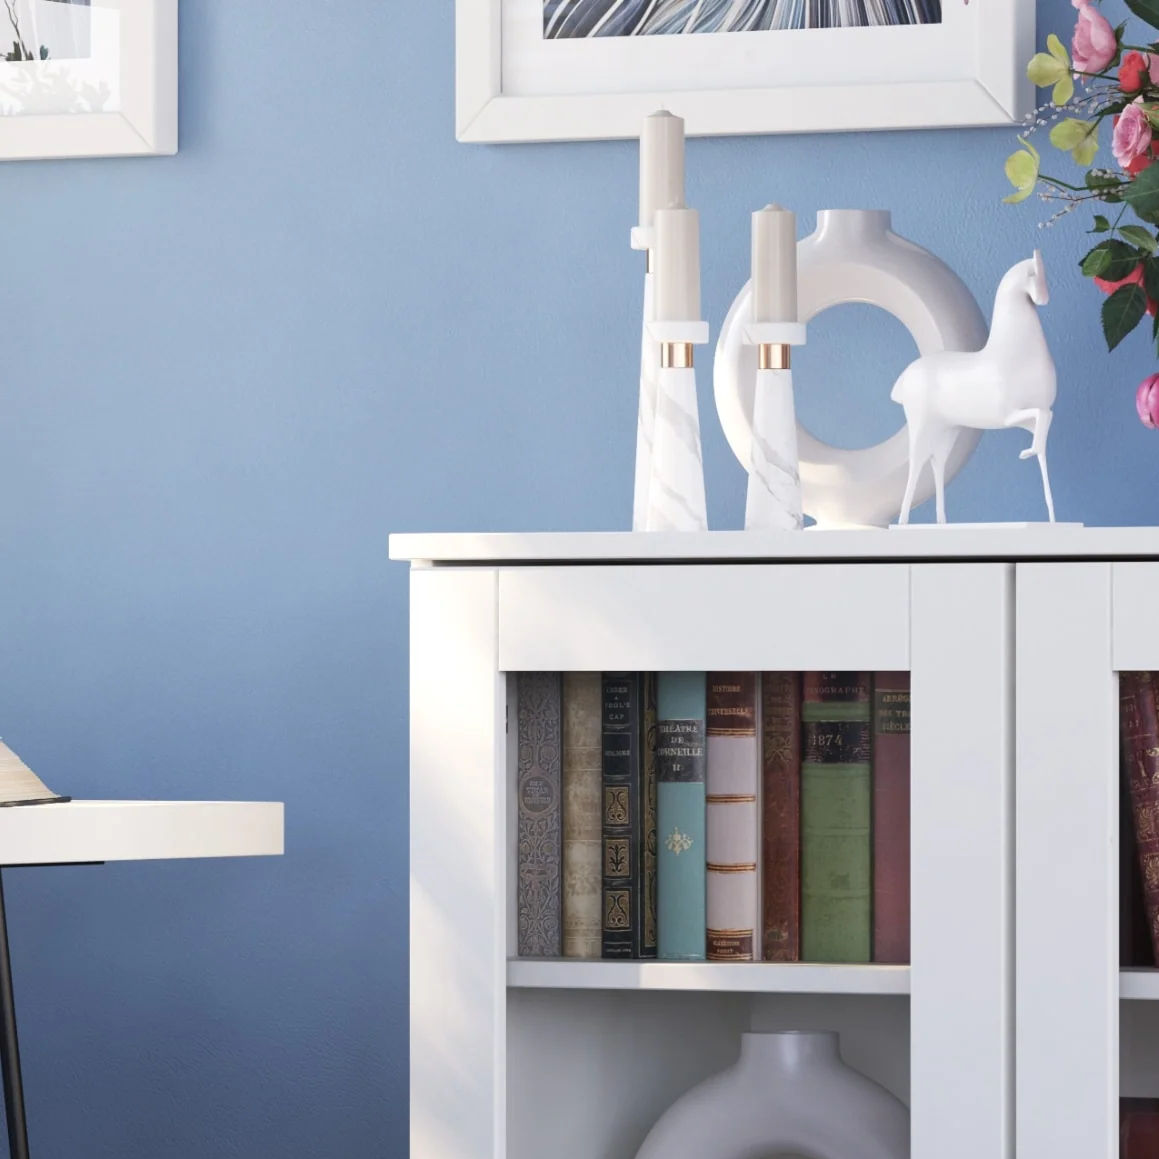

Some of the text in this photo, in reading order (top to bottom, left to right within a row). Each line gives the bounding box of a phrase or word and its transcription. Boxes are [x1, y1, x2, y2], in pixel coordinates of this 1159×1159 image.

[670, 736, 685, 744] DE
[812, 734, 843, 746] 1874
[657, 747, 704, 757] CORNEILLE
